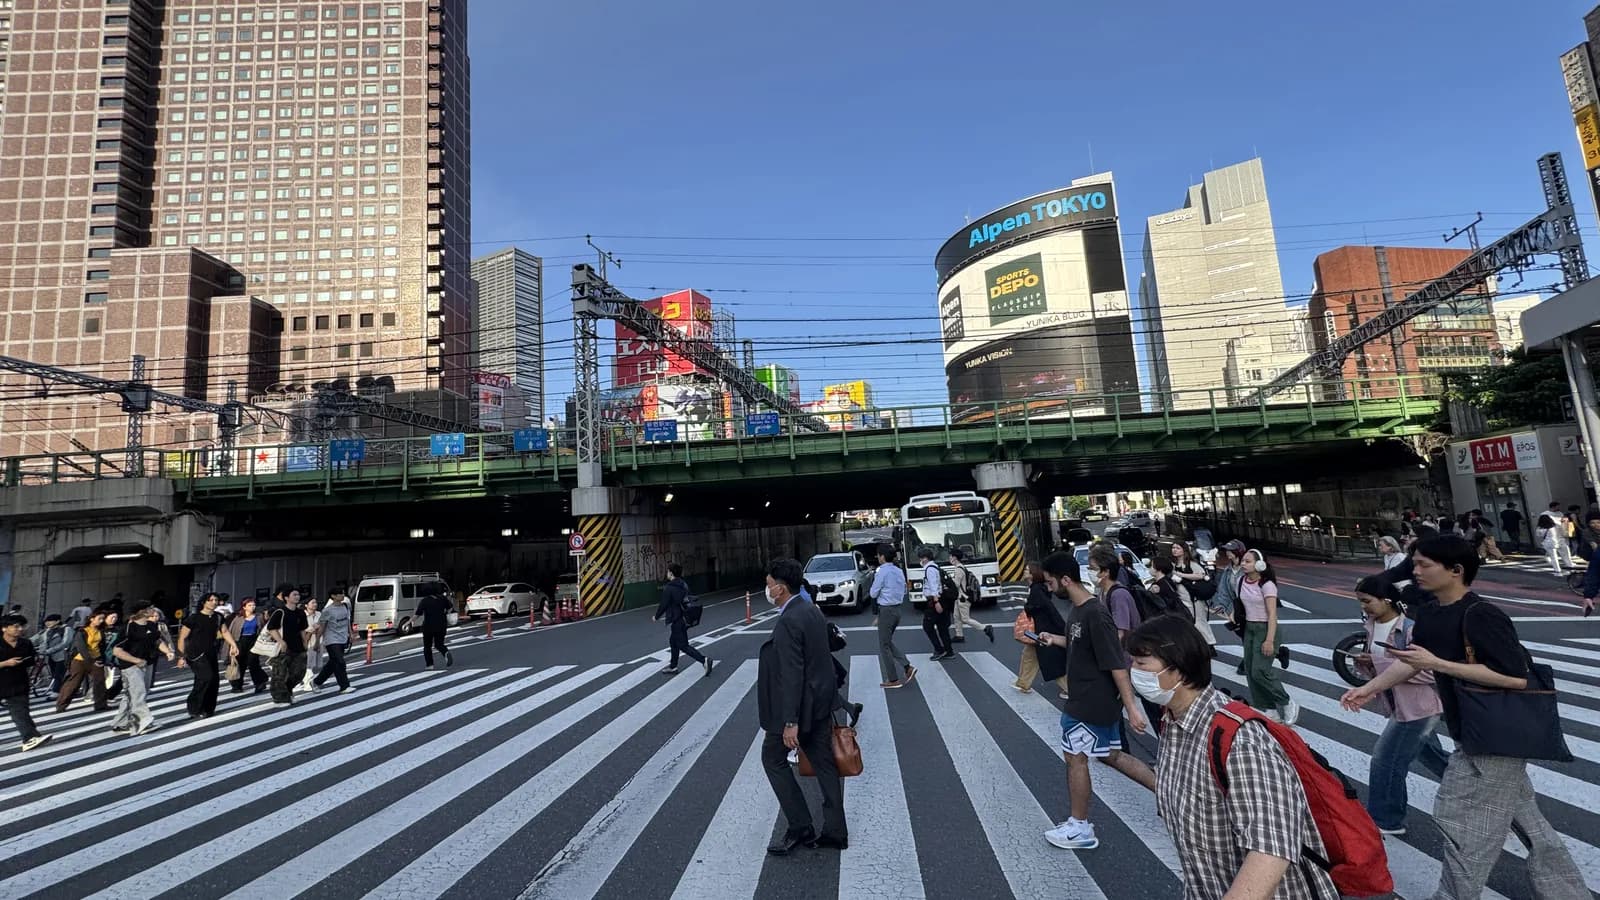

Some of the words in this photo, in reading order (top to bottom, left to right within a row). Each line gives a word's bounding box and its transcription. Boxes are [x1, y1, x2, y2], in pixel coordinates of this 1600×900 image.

[969, 211, 1031, 248] Alpen
[1031, 191, 1106, 221] TOKYO
[996, 268, 1030, 285] SPORTS
[990, 274, 1039, 299] DEPO
[991, 293, 1041, 311] FLAGSHIP
[1009, 299, 1042, 313] STORE
[1026, 315, 1060, 329] YUNIKA
[1062, 310, 1088, 321] BLDG.
[965, 355, 987, 369] YUNIKA
[987, 348, 1013, 361] VISION
[1476, 442, 1510, 462] ATM
[1516, 441, 1536, 452] EPOS
